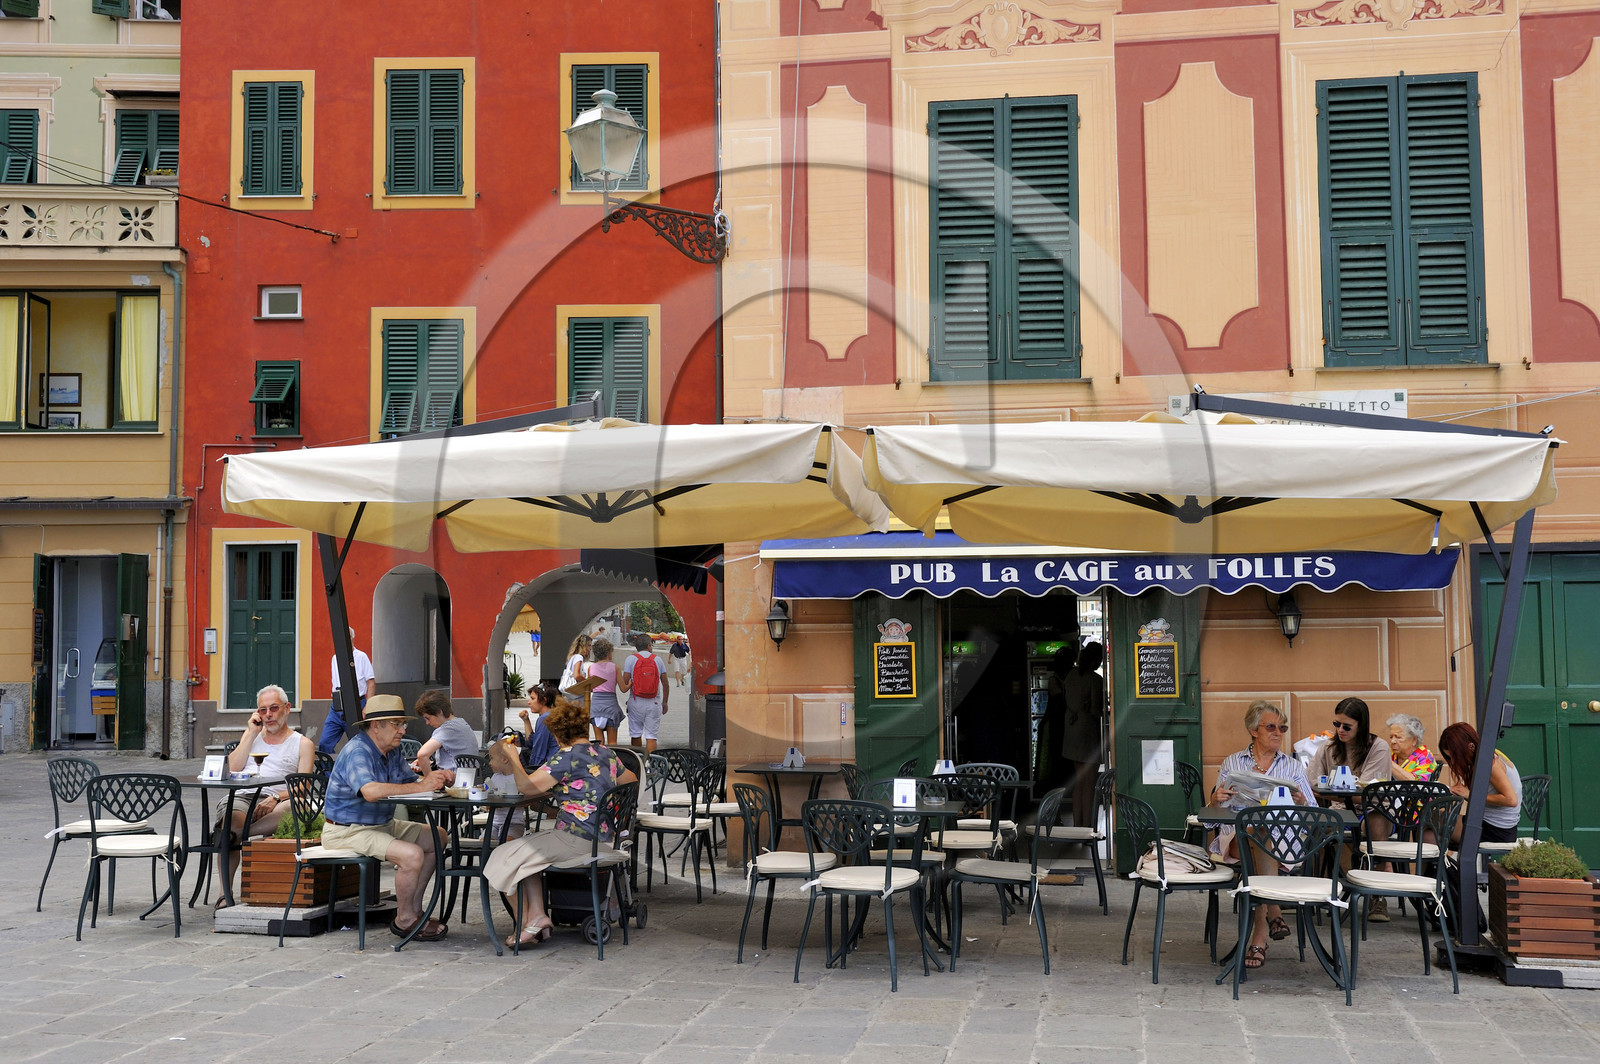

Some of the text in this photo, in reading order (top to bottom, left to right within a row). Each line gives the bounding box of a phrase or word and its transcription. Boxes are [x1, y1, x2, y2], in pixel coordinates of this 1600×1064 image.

[890, 556, 1337, 585] PUB La CAGE aux FOLLES
